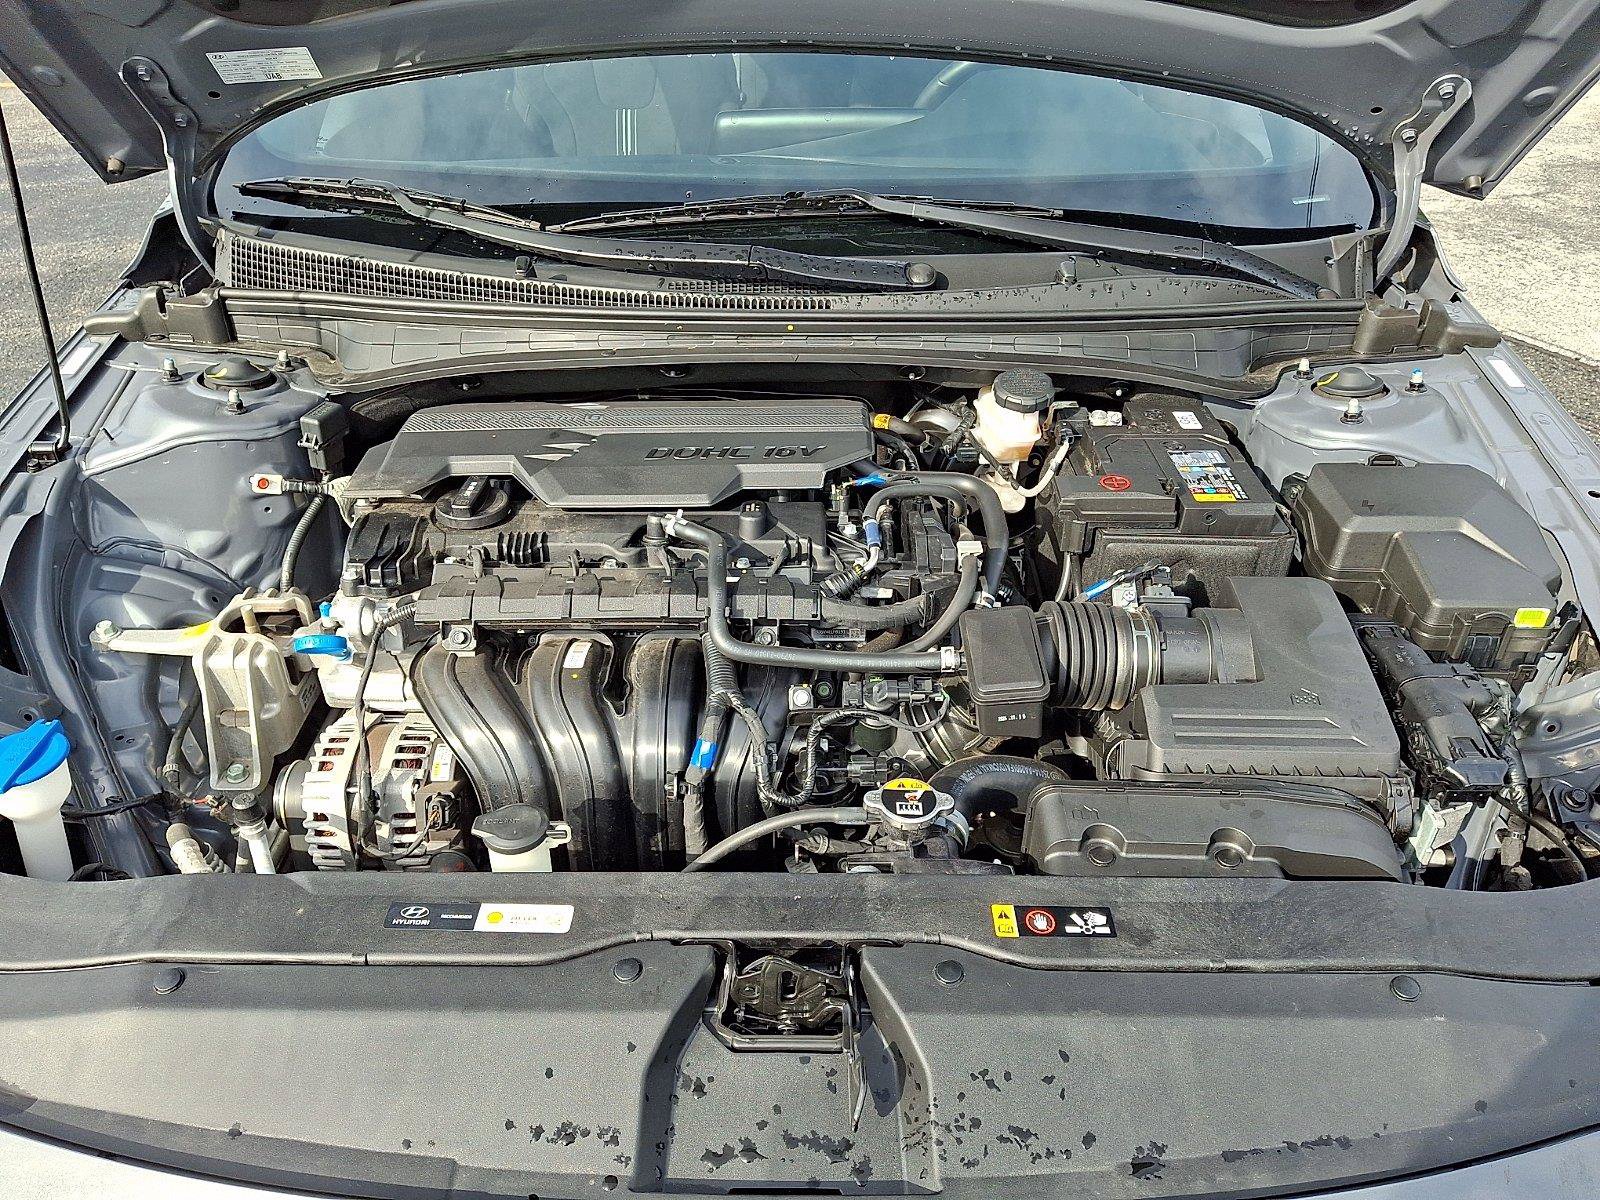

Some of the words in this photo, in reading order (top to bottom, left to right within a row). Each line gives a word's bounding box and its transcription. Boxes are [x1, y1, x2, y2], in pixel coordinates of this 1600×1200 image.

[643, 446, 756, 461] DOHC
[763, 445, 828, 460] 16V
[392, 918, 430, 926] HYUNDAI
